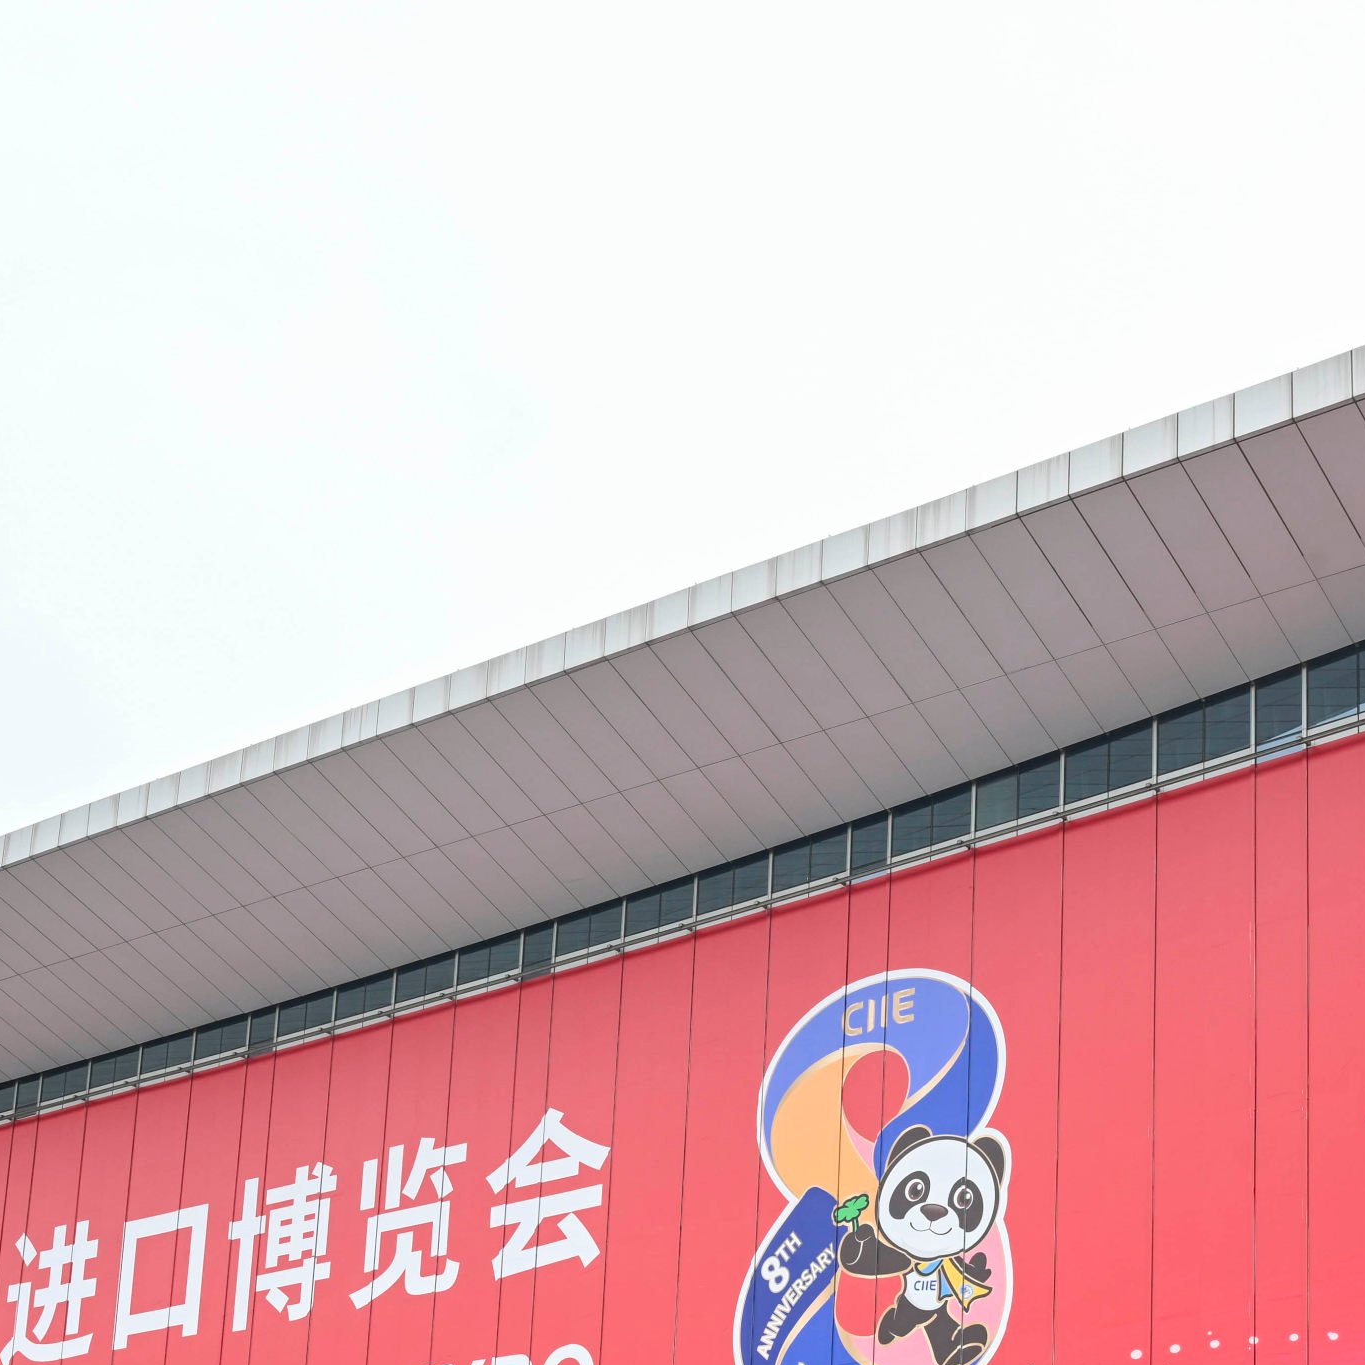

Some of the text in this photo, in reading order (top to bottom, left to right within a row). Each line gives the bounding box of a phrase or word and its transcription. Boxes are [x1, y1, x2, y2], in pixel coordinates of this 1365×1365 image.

[843, 986, 916, 1037] CIIE
[760, 1231, 803, 1294] 8TH
[914, 1280, 938, 1291] CIIE
[756, 1242, 837, 1360] ANNIVERSARY
